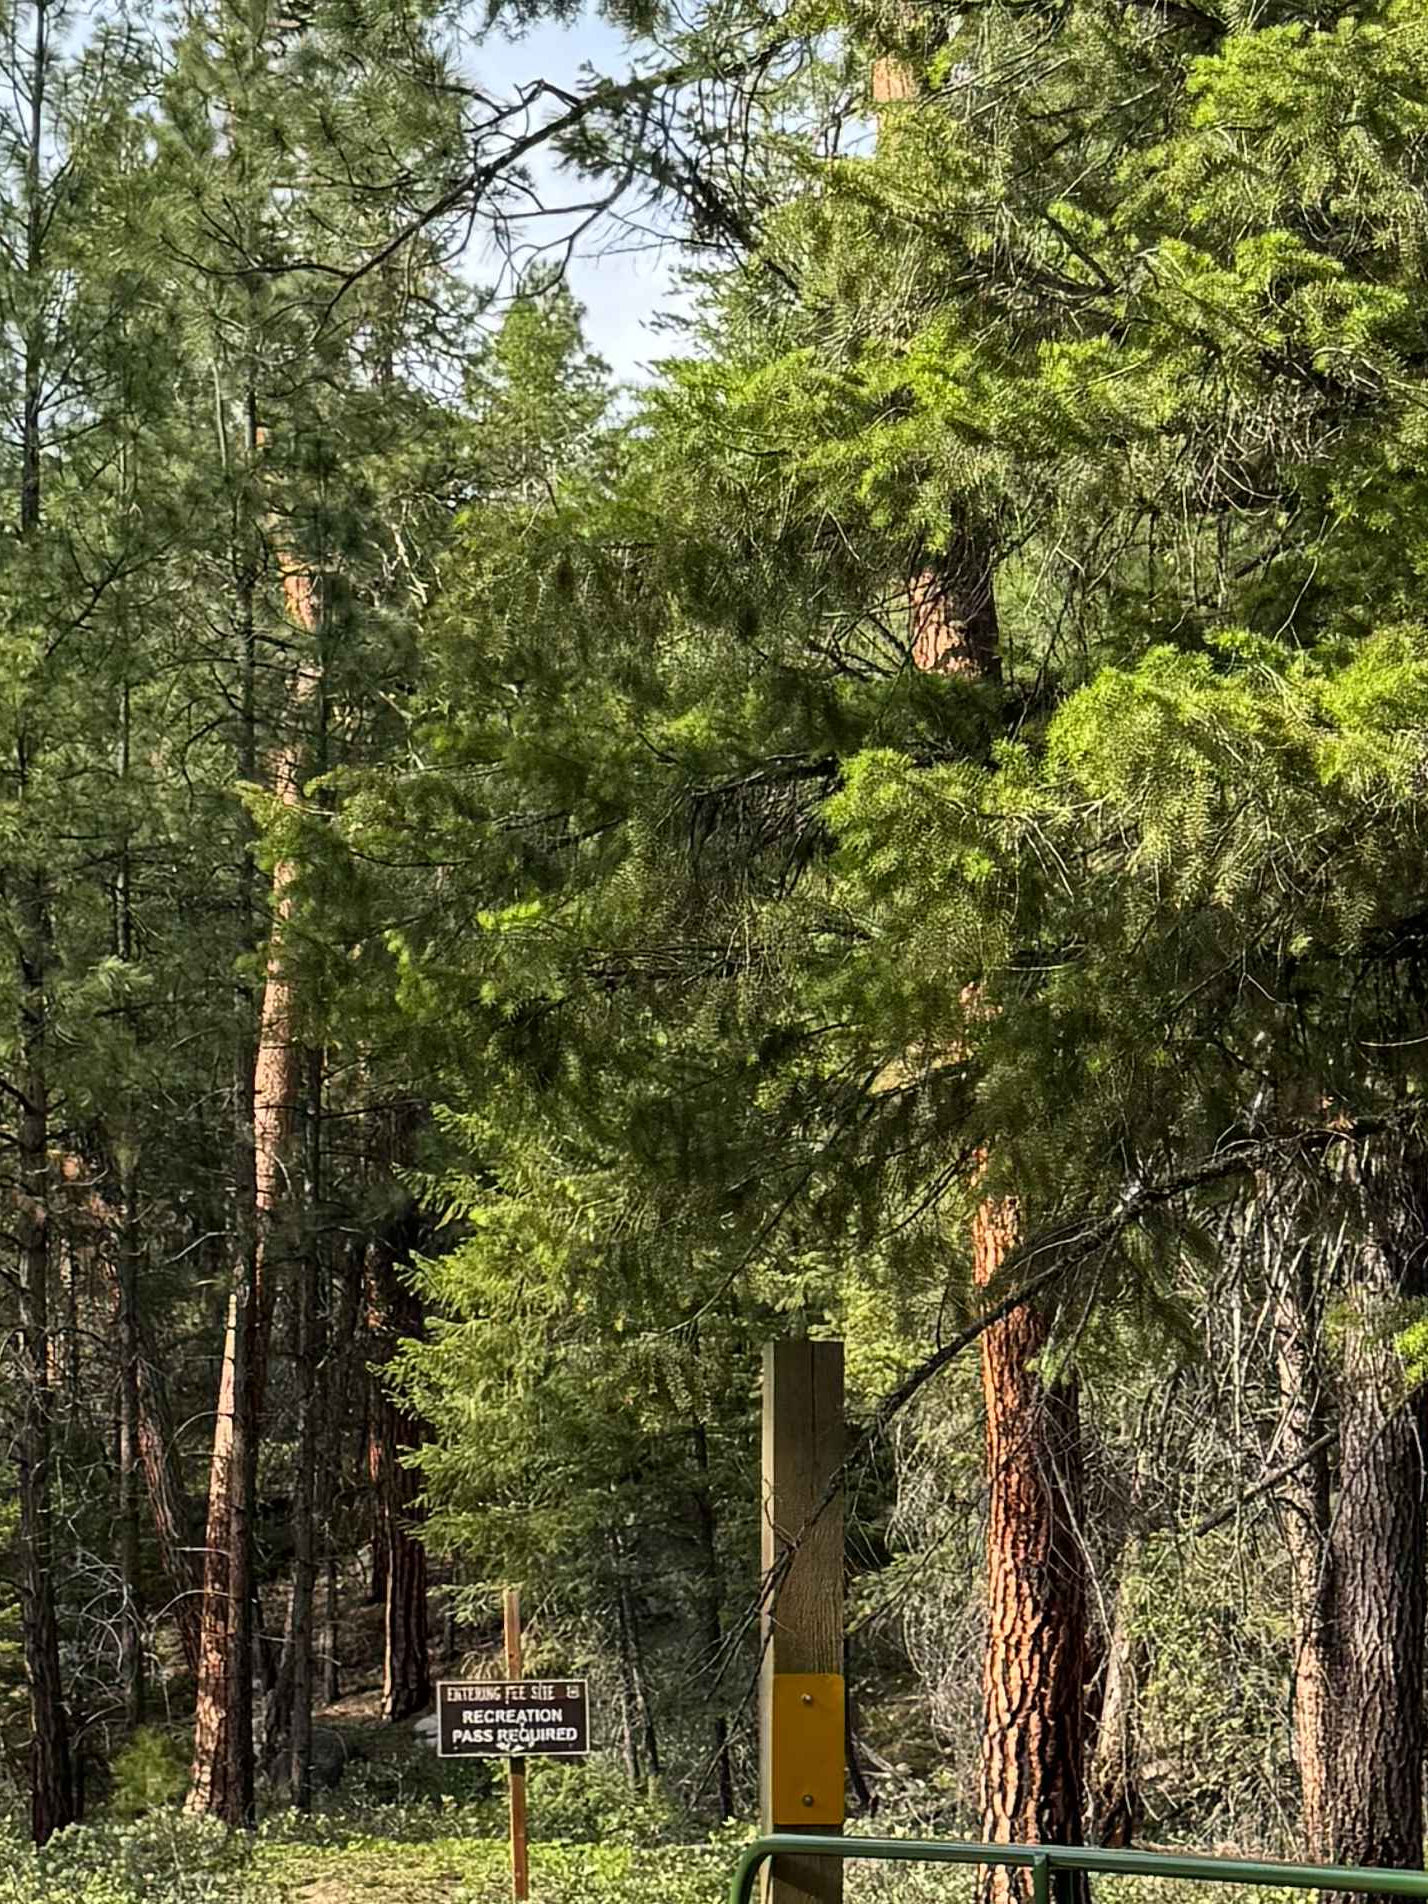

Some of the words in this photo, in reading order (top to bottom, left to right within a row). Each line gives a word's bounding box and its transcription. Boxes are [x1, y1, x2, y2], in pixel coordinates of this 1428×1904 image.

[447, 1686, 502, 1702] ENTERING
[506, 1686, 527, 1701] FEE
[531, 1685, 556, 1701] SITE
[462, 1708, 563, 1724] RECREATION
[452, 1729, 494, 1744] PASS
[497, 1727, 578, 1743] REQUIRED
